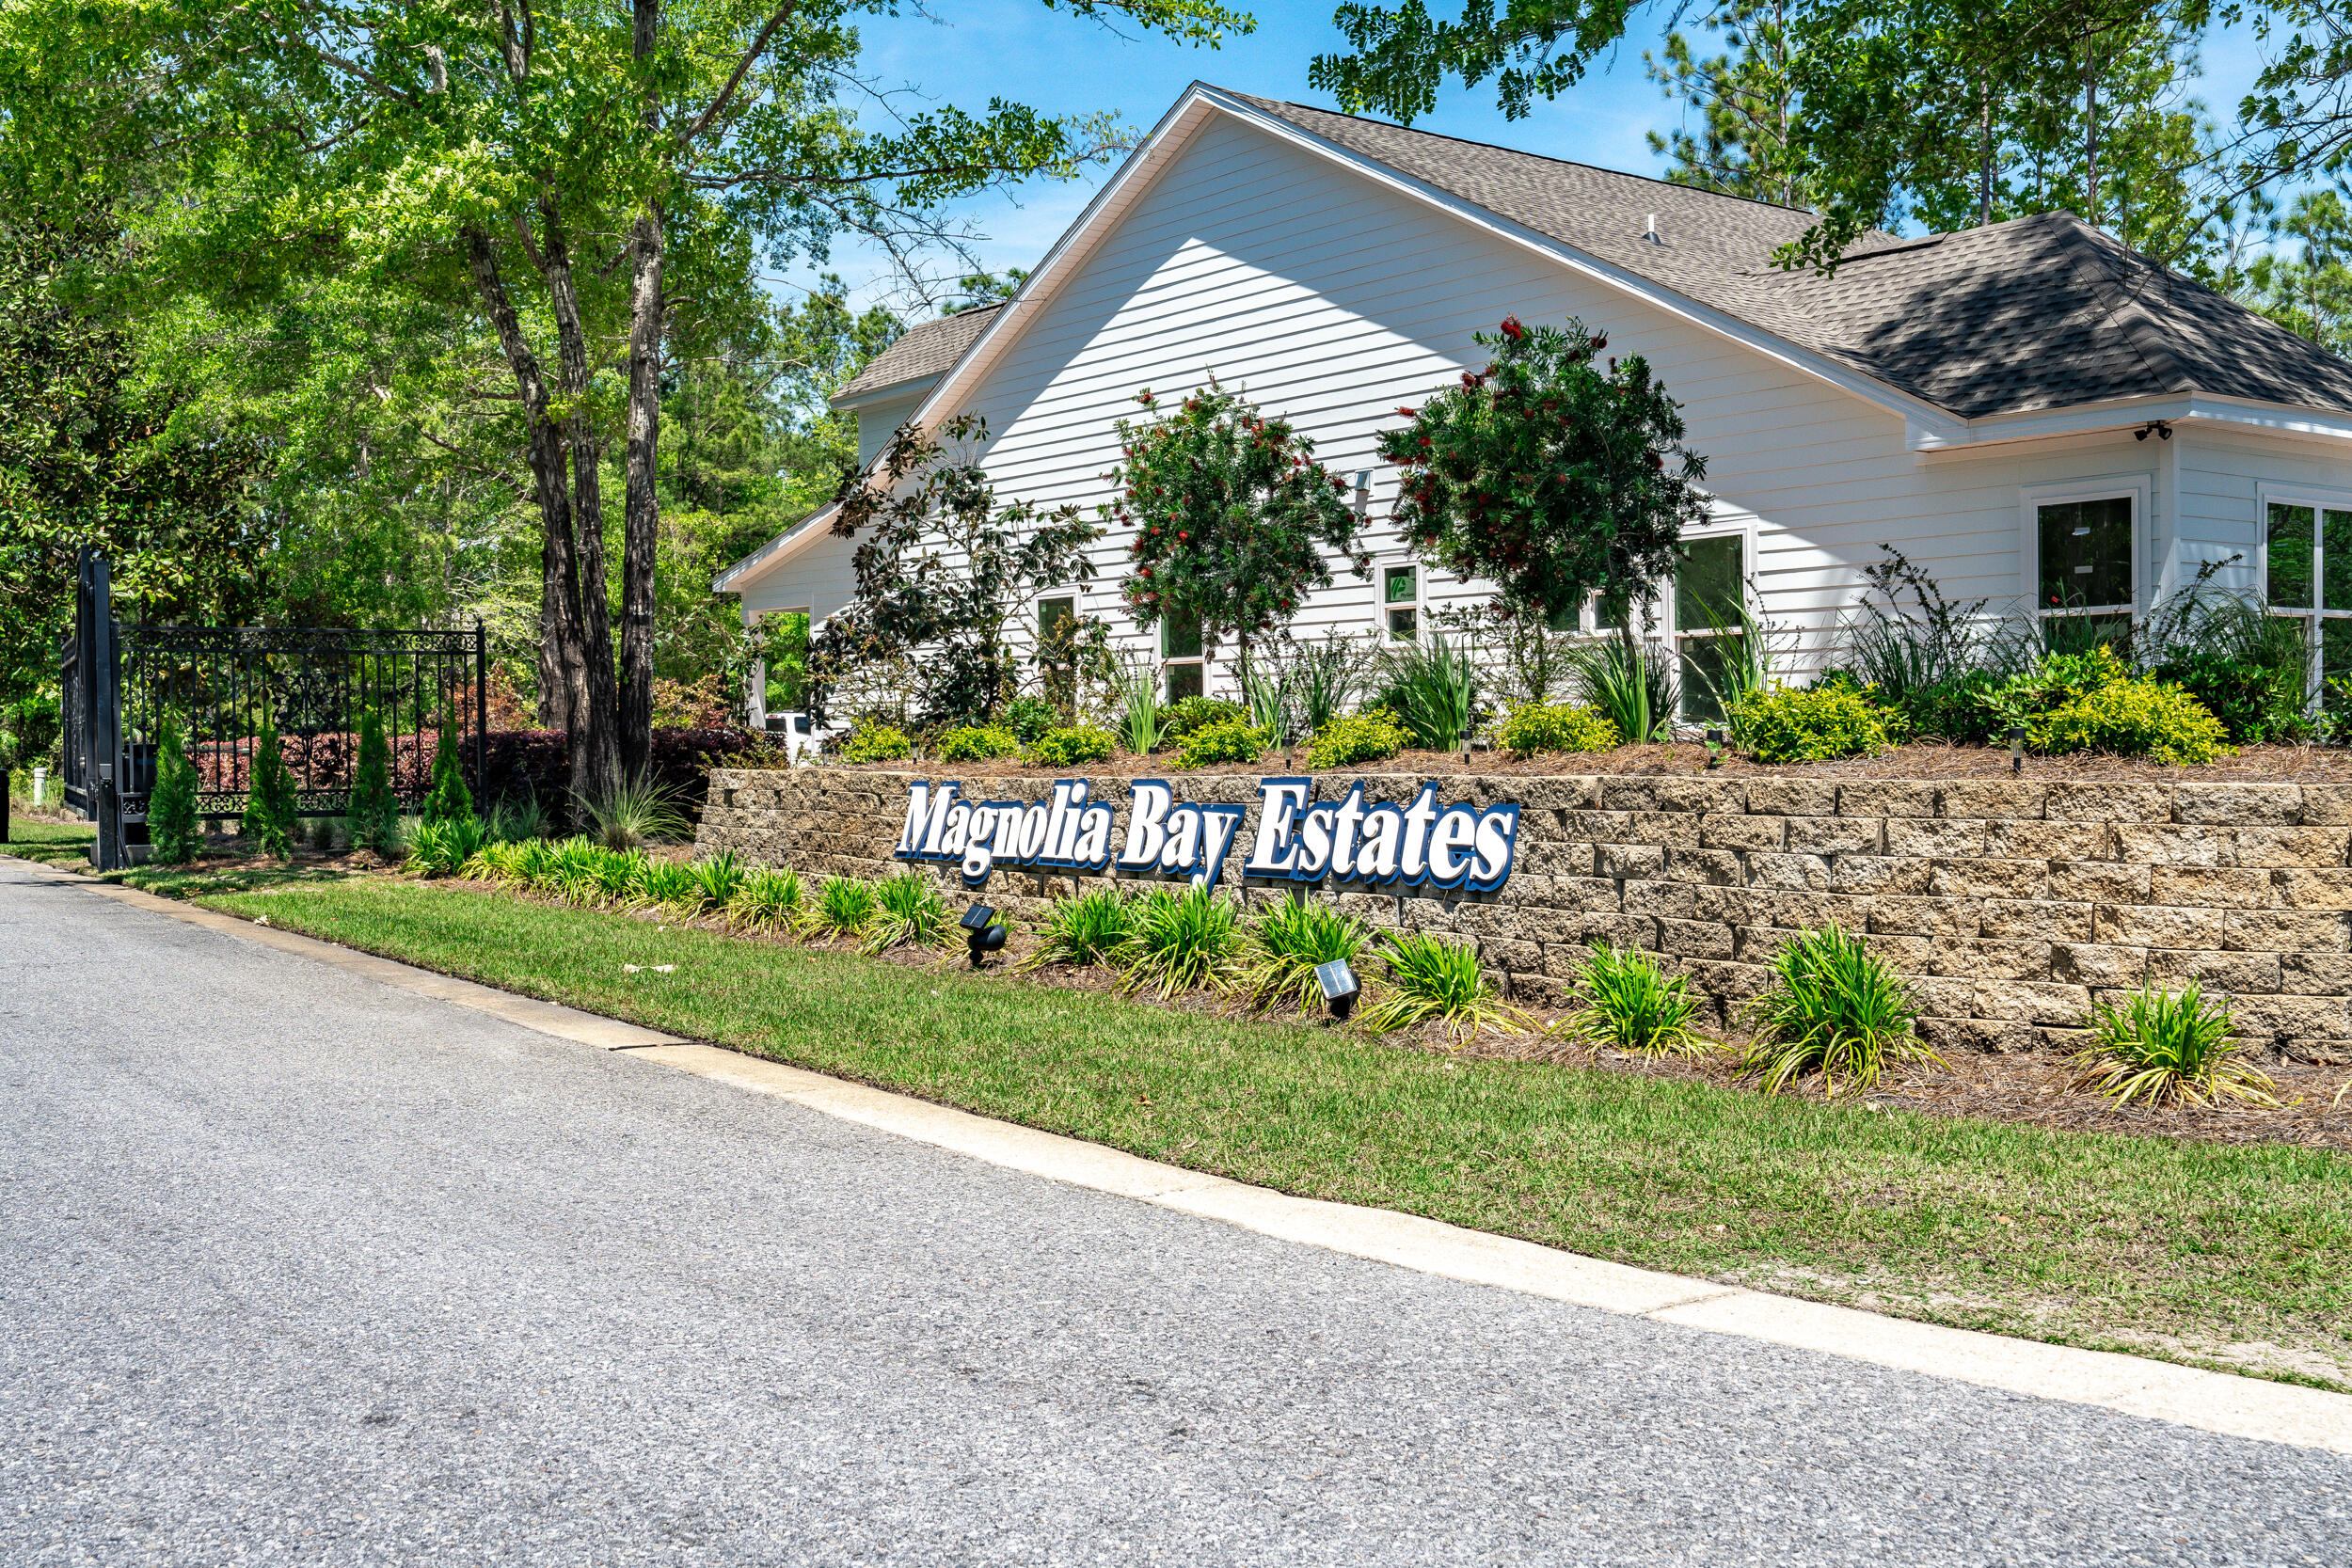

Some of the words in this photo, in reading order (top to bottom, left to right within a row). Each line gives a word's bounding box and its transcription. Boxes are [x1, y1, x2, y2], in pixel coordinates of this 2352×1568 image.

[895, 782, 1112, 880] Magnolia
[1118, 784, 1241, 893] Bay
[1245, 783, 1515, 883] Estates
